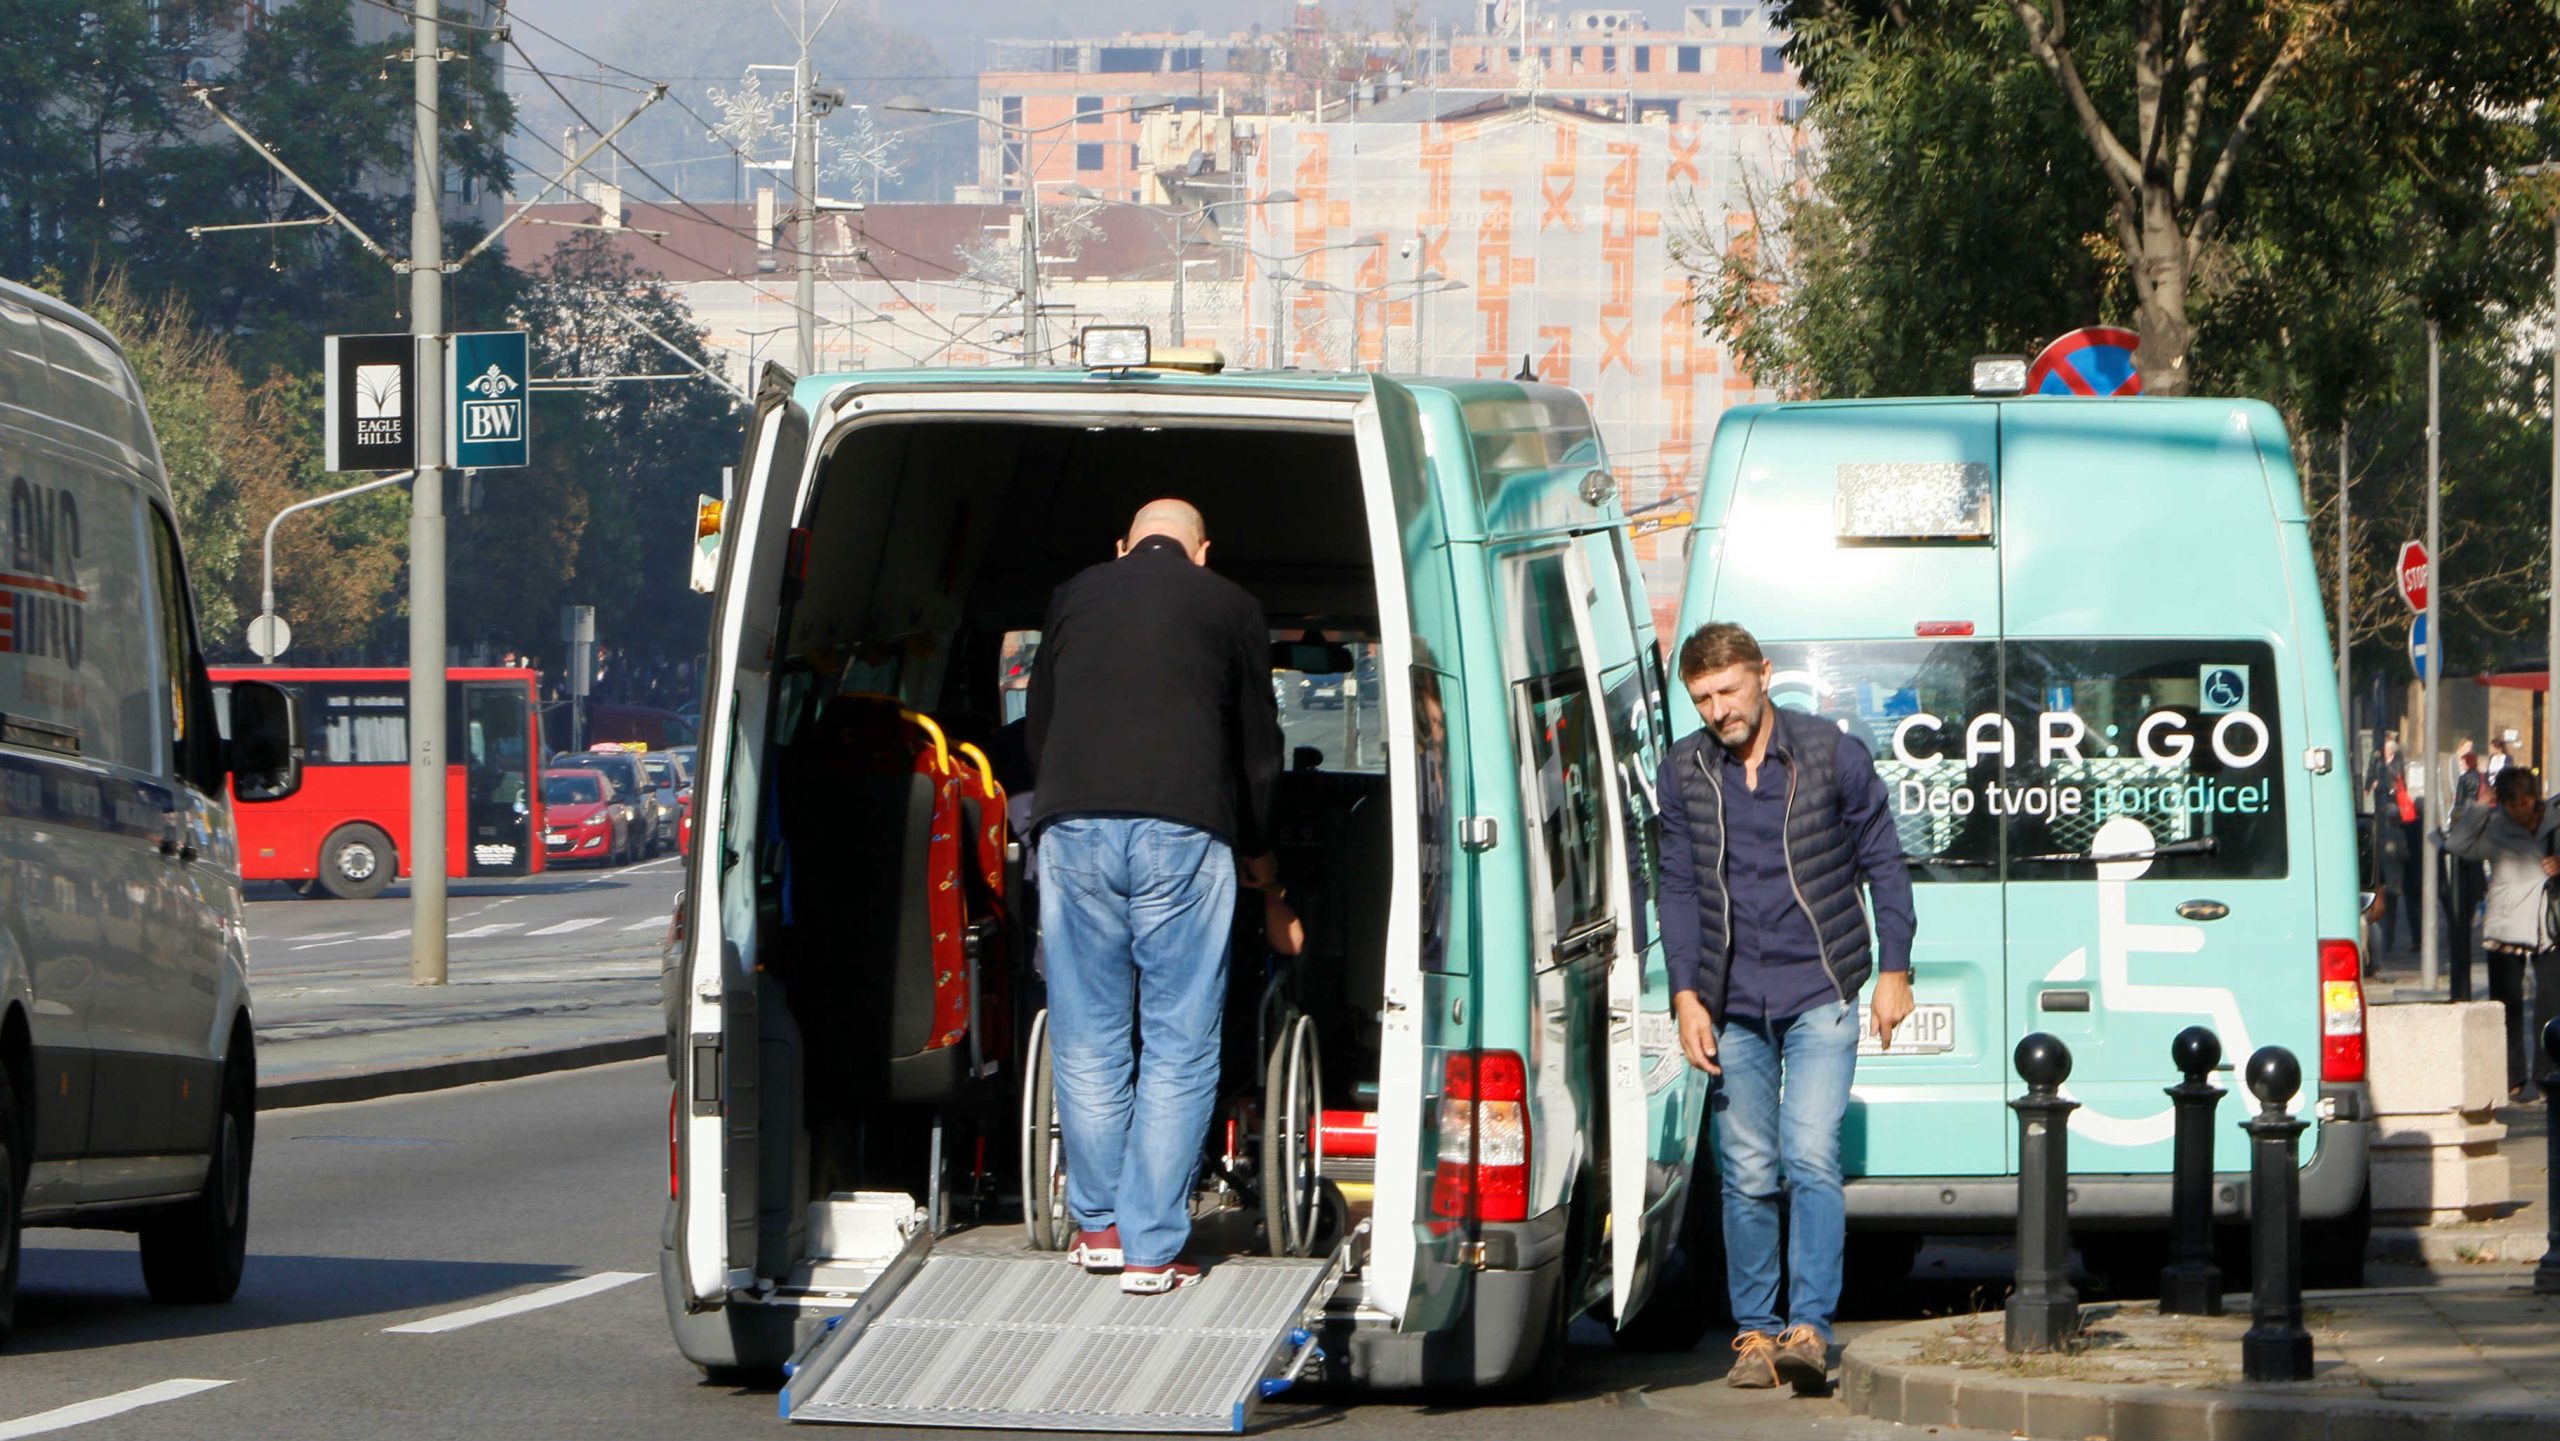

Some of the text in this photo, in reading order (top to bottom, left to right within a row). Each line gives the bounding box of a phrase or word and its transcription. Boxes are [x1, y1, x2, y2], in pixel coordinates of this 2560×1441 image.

[357, 420, 401, 433] EAGLE
[469, 405, 516, 438] BW
[357, 432, 402, 445] HILLS
[1900, 776, 2269, 825] Deo tvoje porodice!
